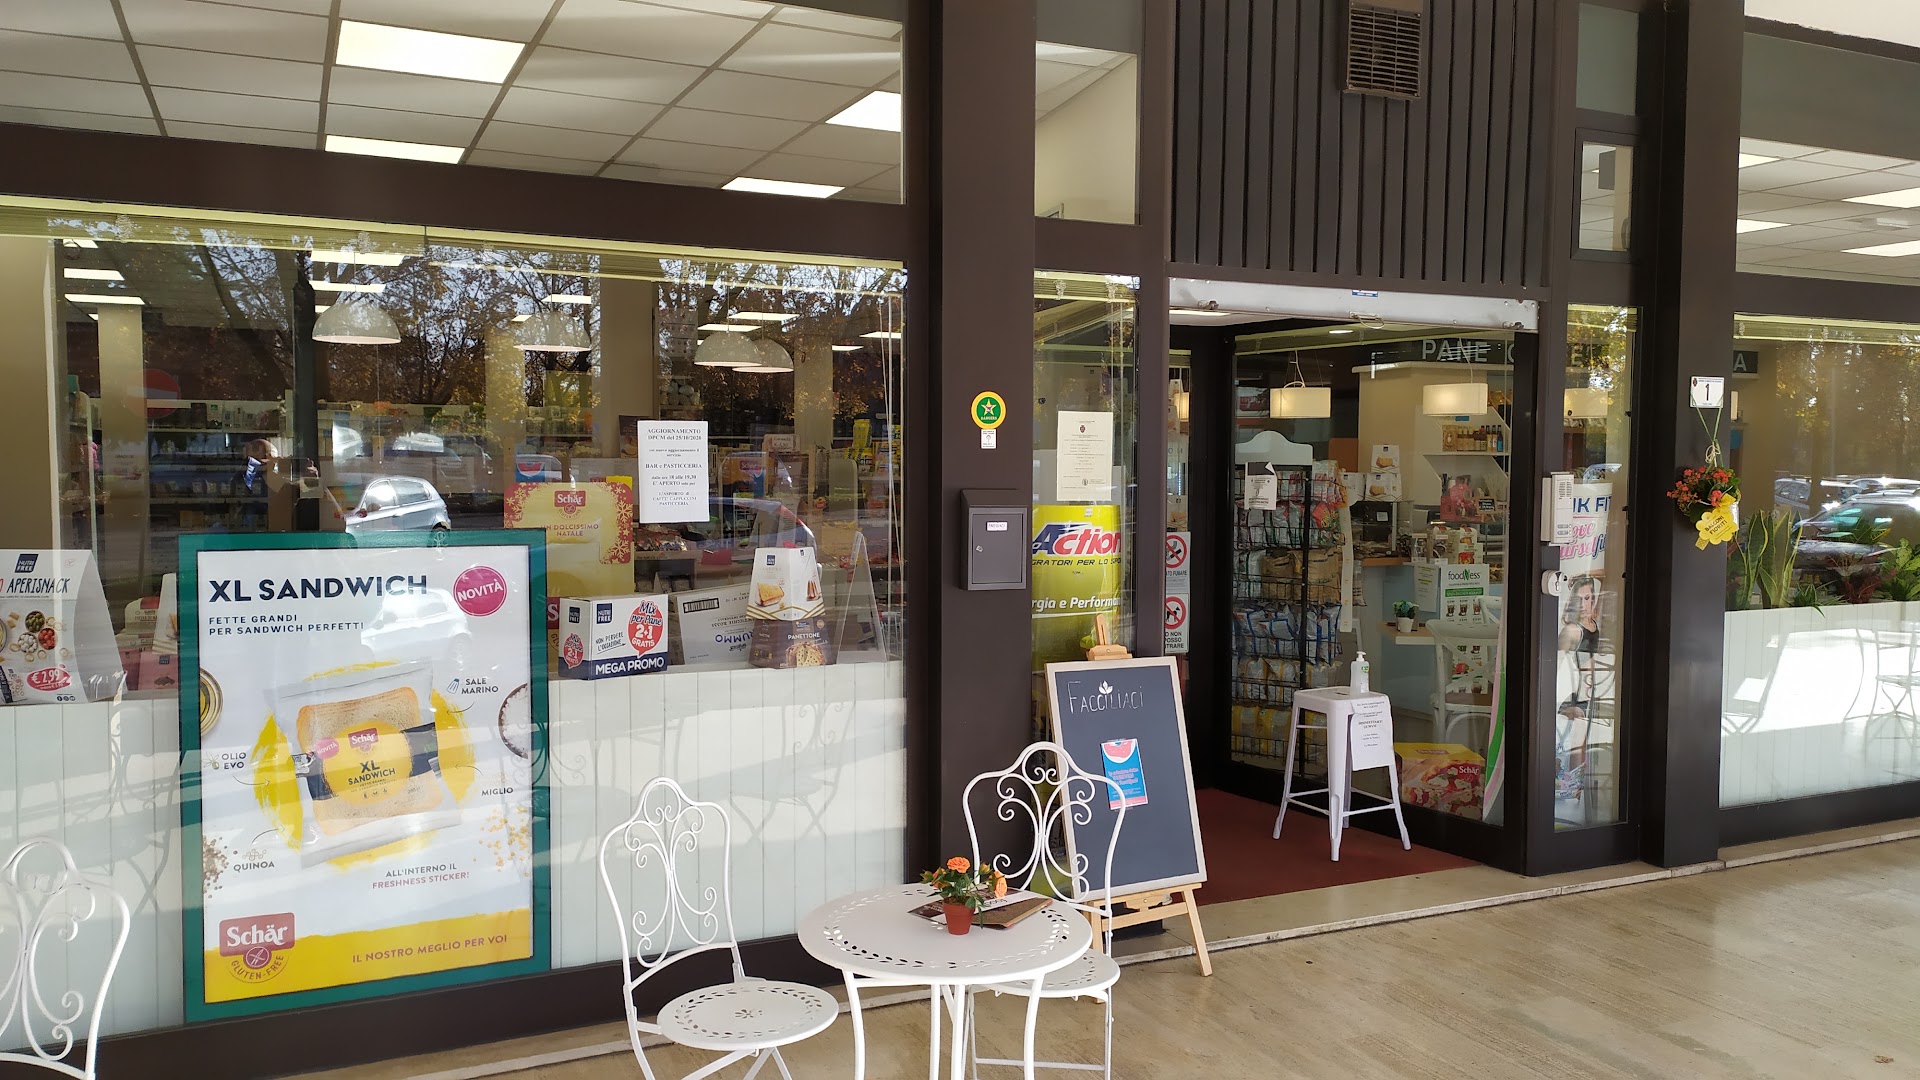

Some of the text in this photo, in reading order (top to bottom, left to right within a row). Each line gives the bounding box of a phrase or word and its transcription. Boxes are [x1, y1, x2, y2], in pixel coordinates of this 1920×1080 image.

[1422, 339, 1488, 362] PANE
[1705, 383, 1710, 401] 1
[557, 494, 584, 506] Schär
[1704, 515, 1724, 532] BALCONI
[1710, 520, 1728, 534] FIORITI
[6, 577, 71, 594] APERISNACK
[208, 575, 427, 602] XL SANDWICH
[457, 579, 504, 602] NOVITÀ
[640, 600, 658, 614] Mix
[1059, 600, 1067, 609] e
[208, 614, 298, 624] FETTE GRANDI
[630, 614, 662, 626] per Pane
[208, 622, 364, 636] PER SANDWICH PERFETTI
[636, 624, 653, 640] 2+1
[788, 632, 820, 640] PANETTONE
[632, 637, 655, 648] GRATIS
[595, 657, 664, 676] MEGA PROMO
[42, 668, 60, 684] 2,99
[466, 678, 487, 686] SALE
[461, 685, 499, 695] MARINO
[351, 733, 376, 745] Schär
[317, 742, 338, 755] NOVITÀ
[221, 752, 246, 760] OLIO
[224, 762, 245, 770] EVO
[360, 760, 380, 774] XL
[1459, 766, 1480, 776] Schär
[348, 768, 396, 786] SANDWICH
[482, 787, 514, 796] MIGLIO
[233, 861, 275, 872] QUINOA
[385, 862, 457, 878] ALL'INTERNO IL
[372, 872, 470, 889] FRESHNESS STICKER!
[226, 924, 288, 947] Schär
[352, 934, 508, 964] IL NOSTRO MEGLIO PER VOI
[230, 955, 284, 980] GLUTEN-FREE
